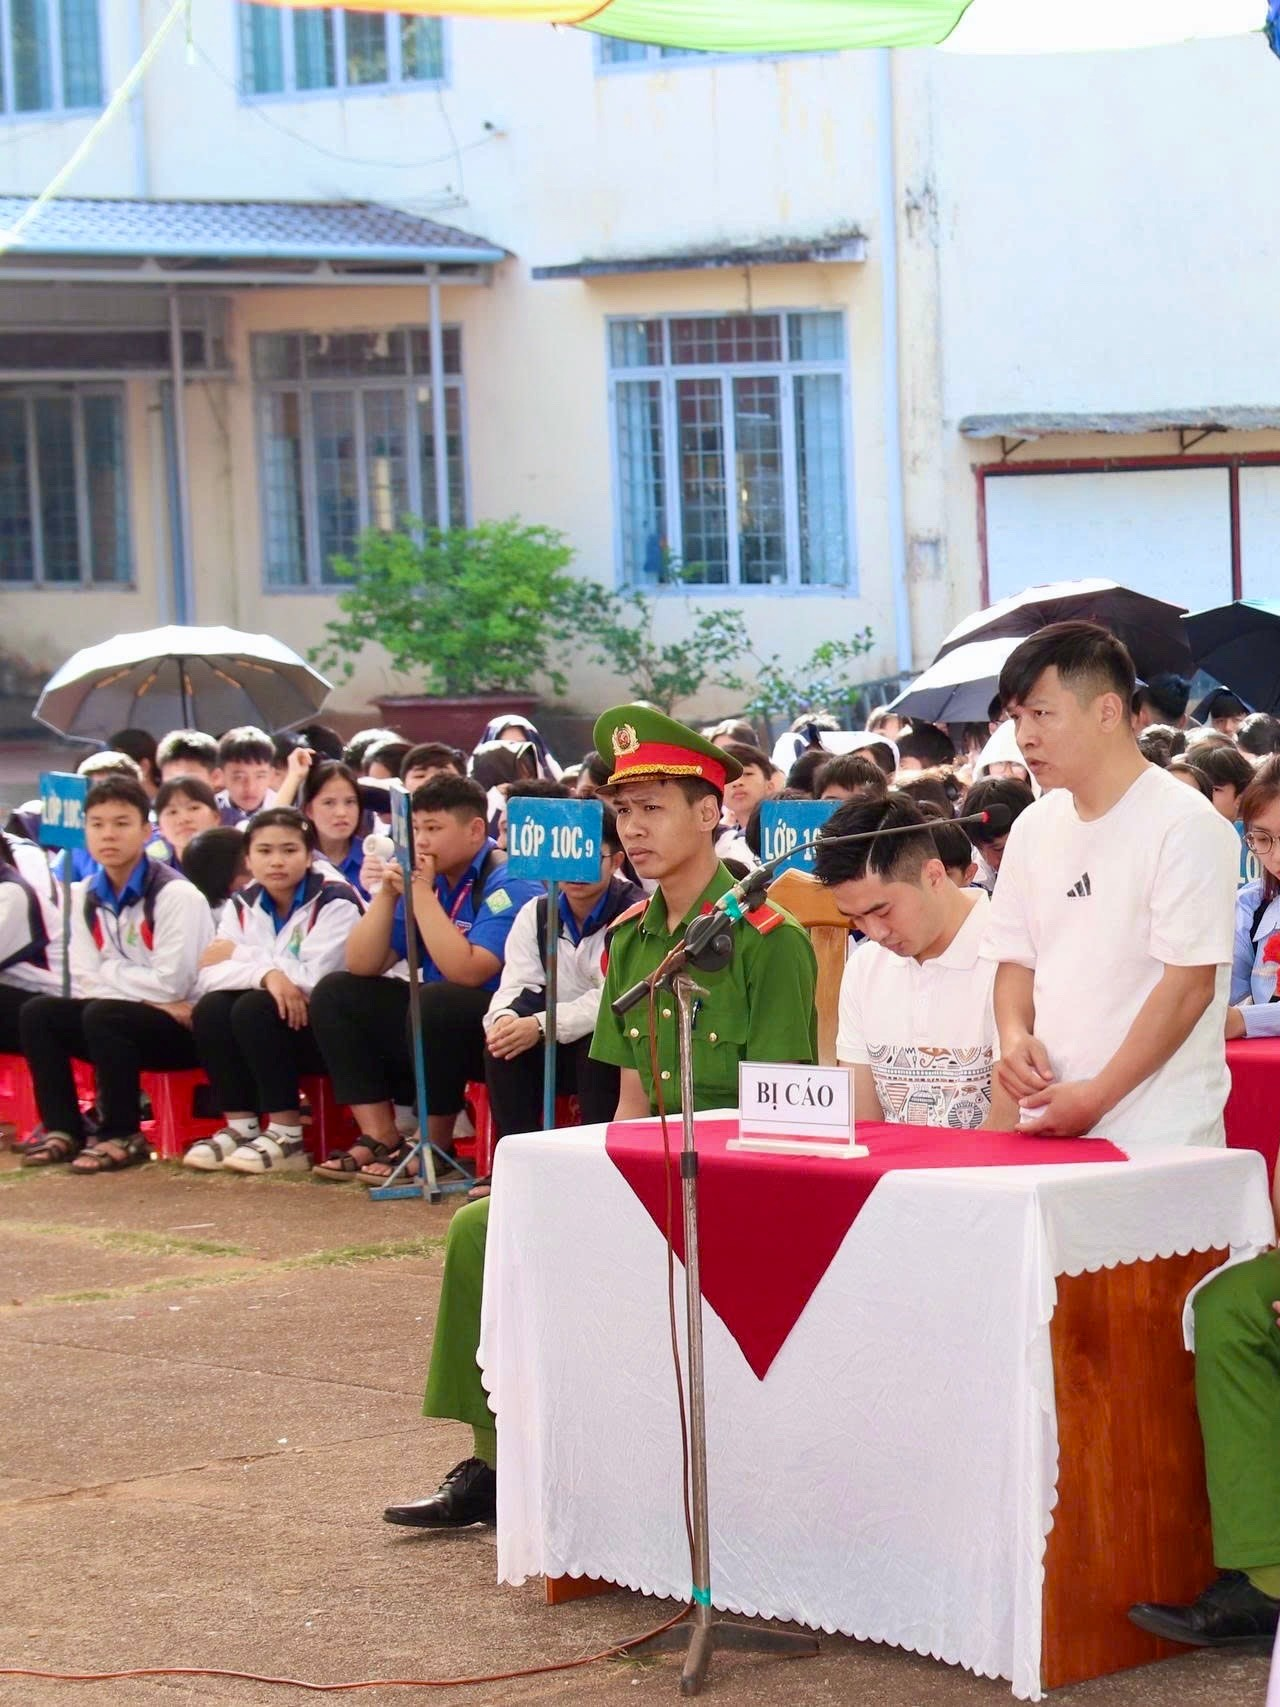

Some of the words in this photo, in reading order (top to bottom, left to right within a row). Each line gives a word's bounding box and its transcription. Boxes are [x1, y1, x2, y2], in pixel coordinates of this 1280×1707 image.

[510, 815, 545, 857] LỚP
[765, 818, 798, 861] LỚP
[757, 1081, 777, 1110] BỊ
[785, 1077, 834, 1107] CÁO
